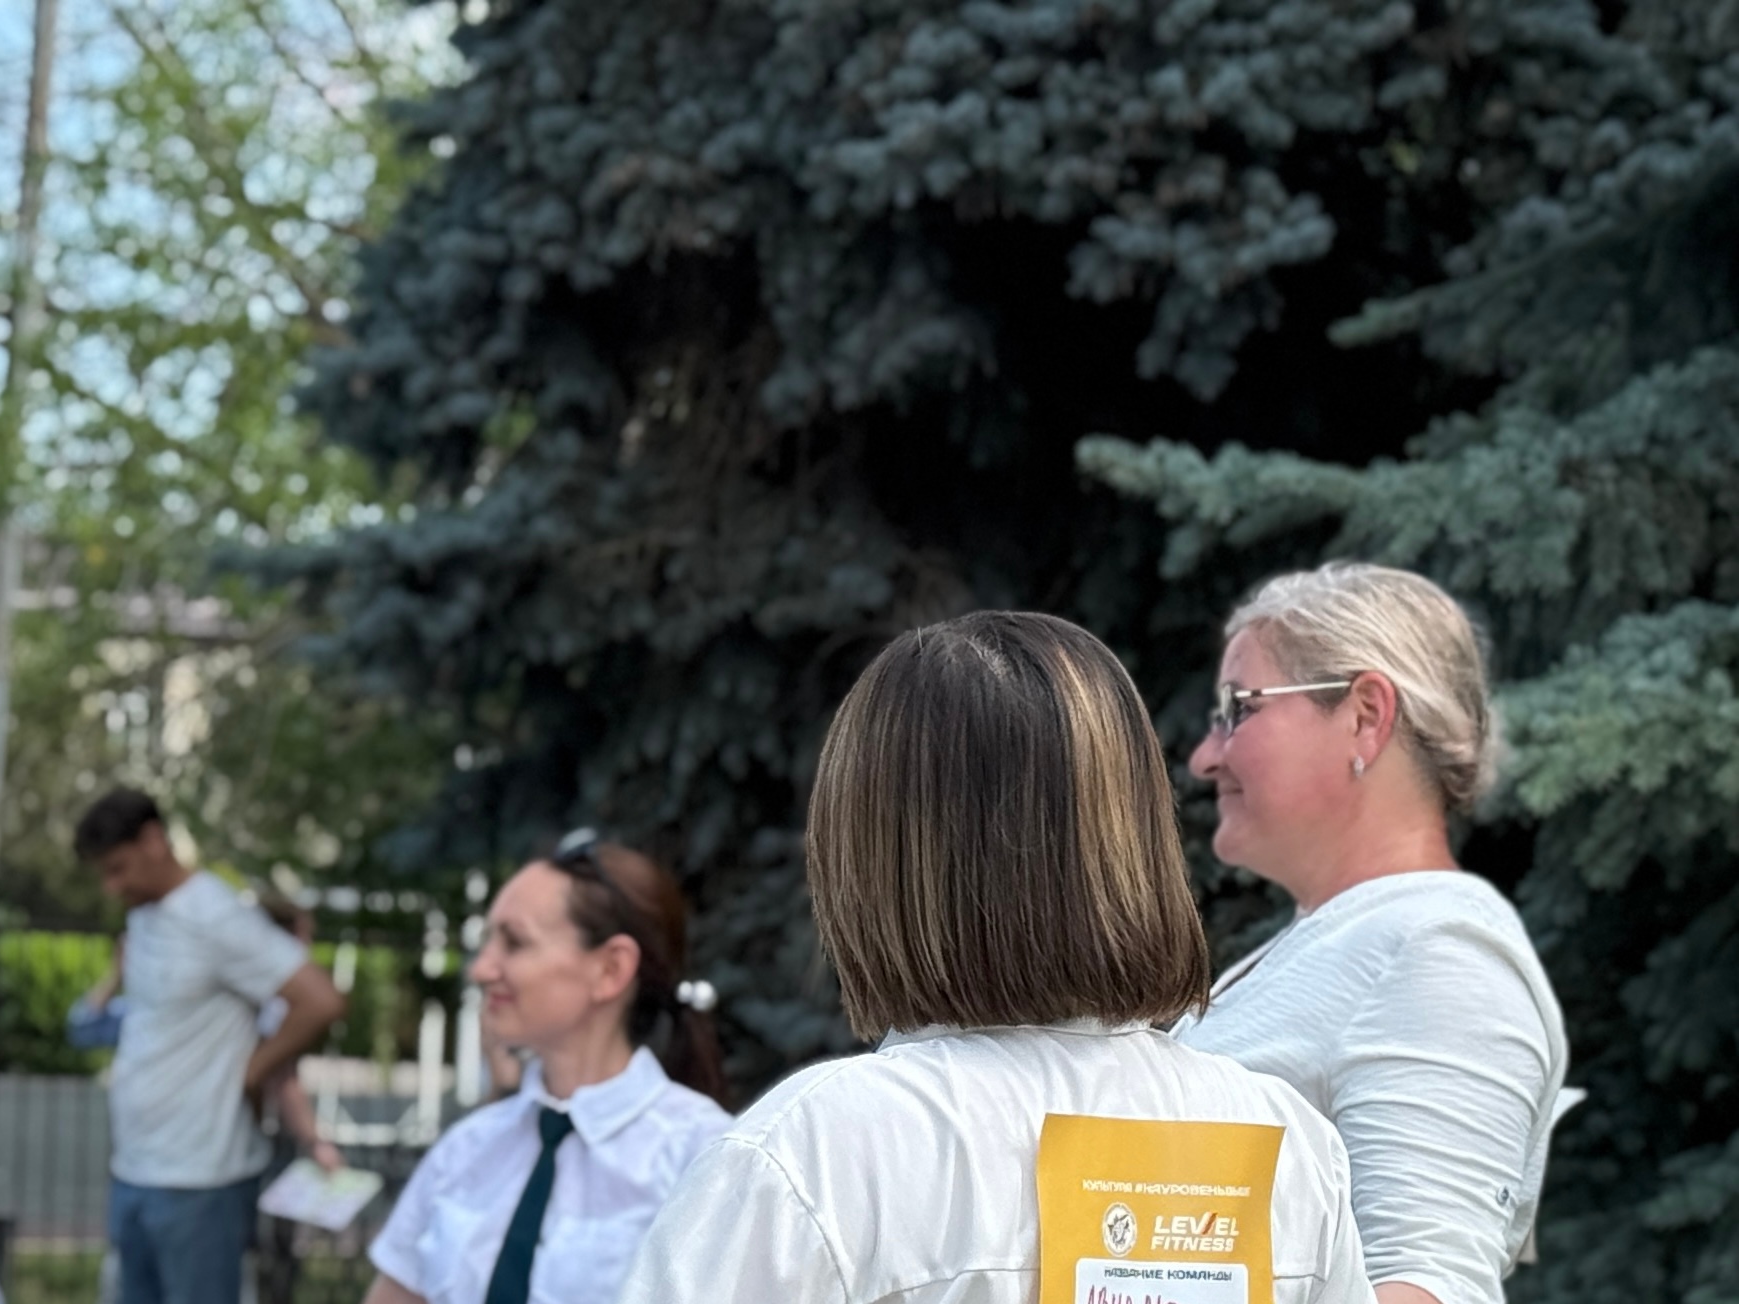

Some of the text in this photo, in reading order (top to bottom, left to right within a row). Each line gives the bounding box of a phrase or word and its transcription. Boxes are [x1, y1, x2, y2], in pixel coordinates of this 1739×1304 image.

[1154, 1211, 1240, 1236] LEVEL
[1150, 1236, 1234, 1252] FITNESS
[1104, 1268, 1232, 1281] НАЗВАНИЕ КОМАНДЫ
